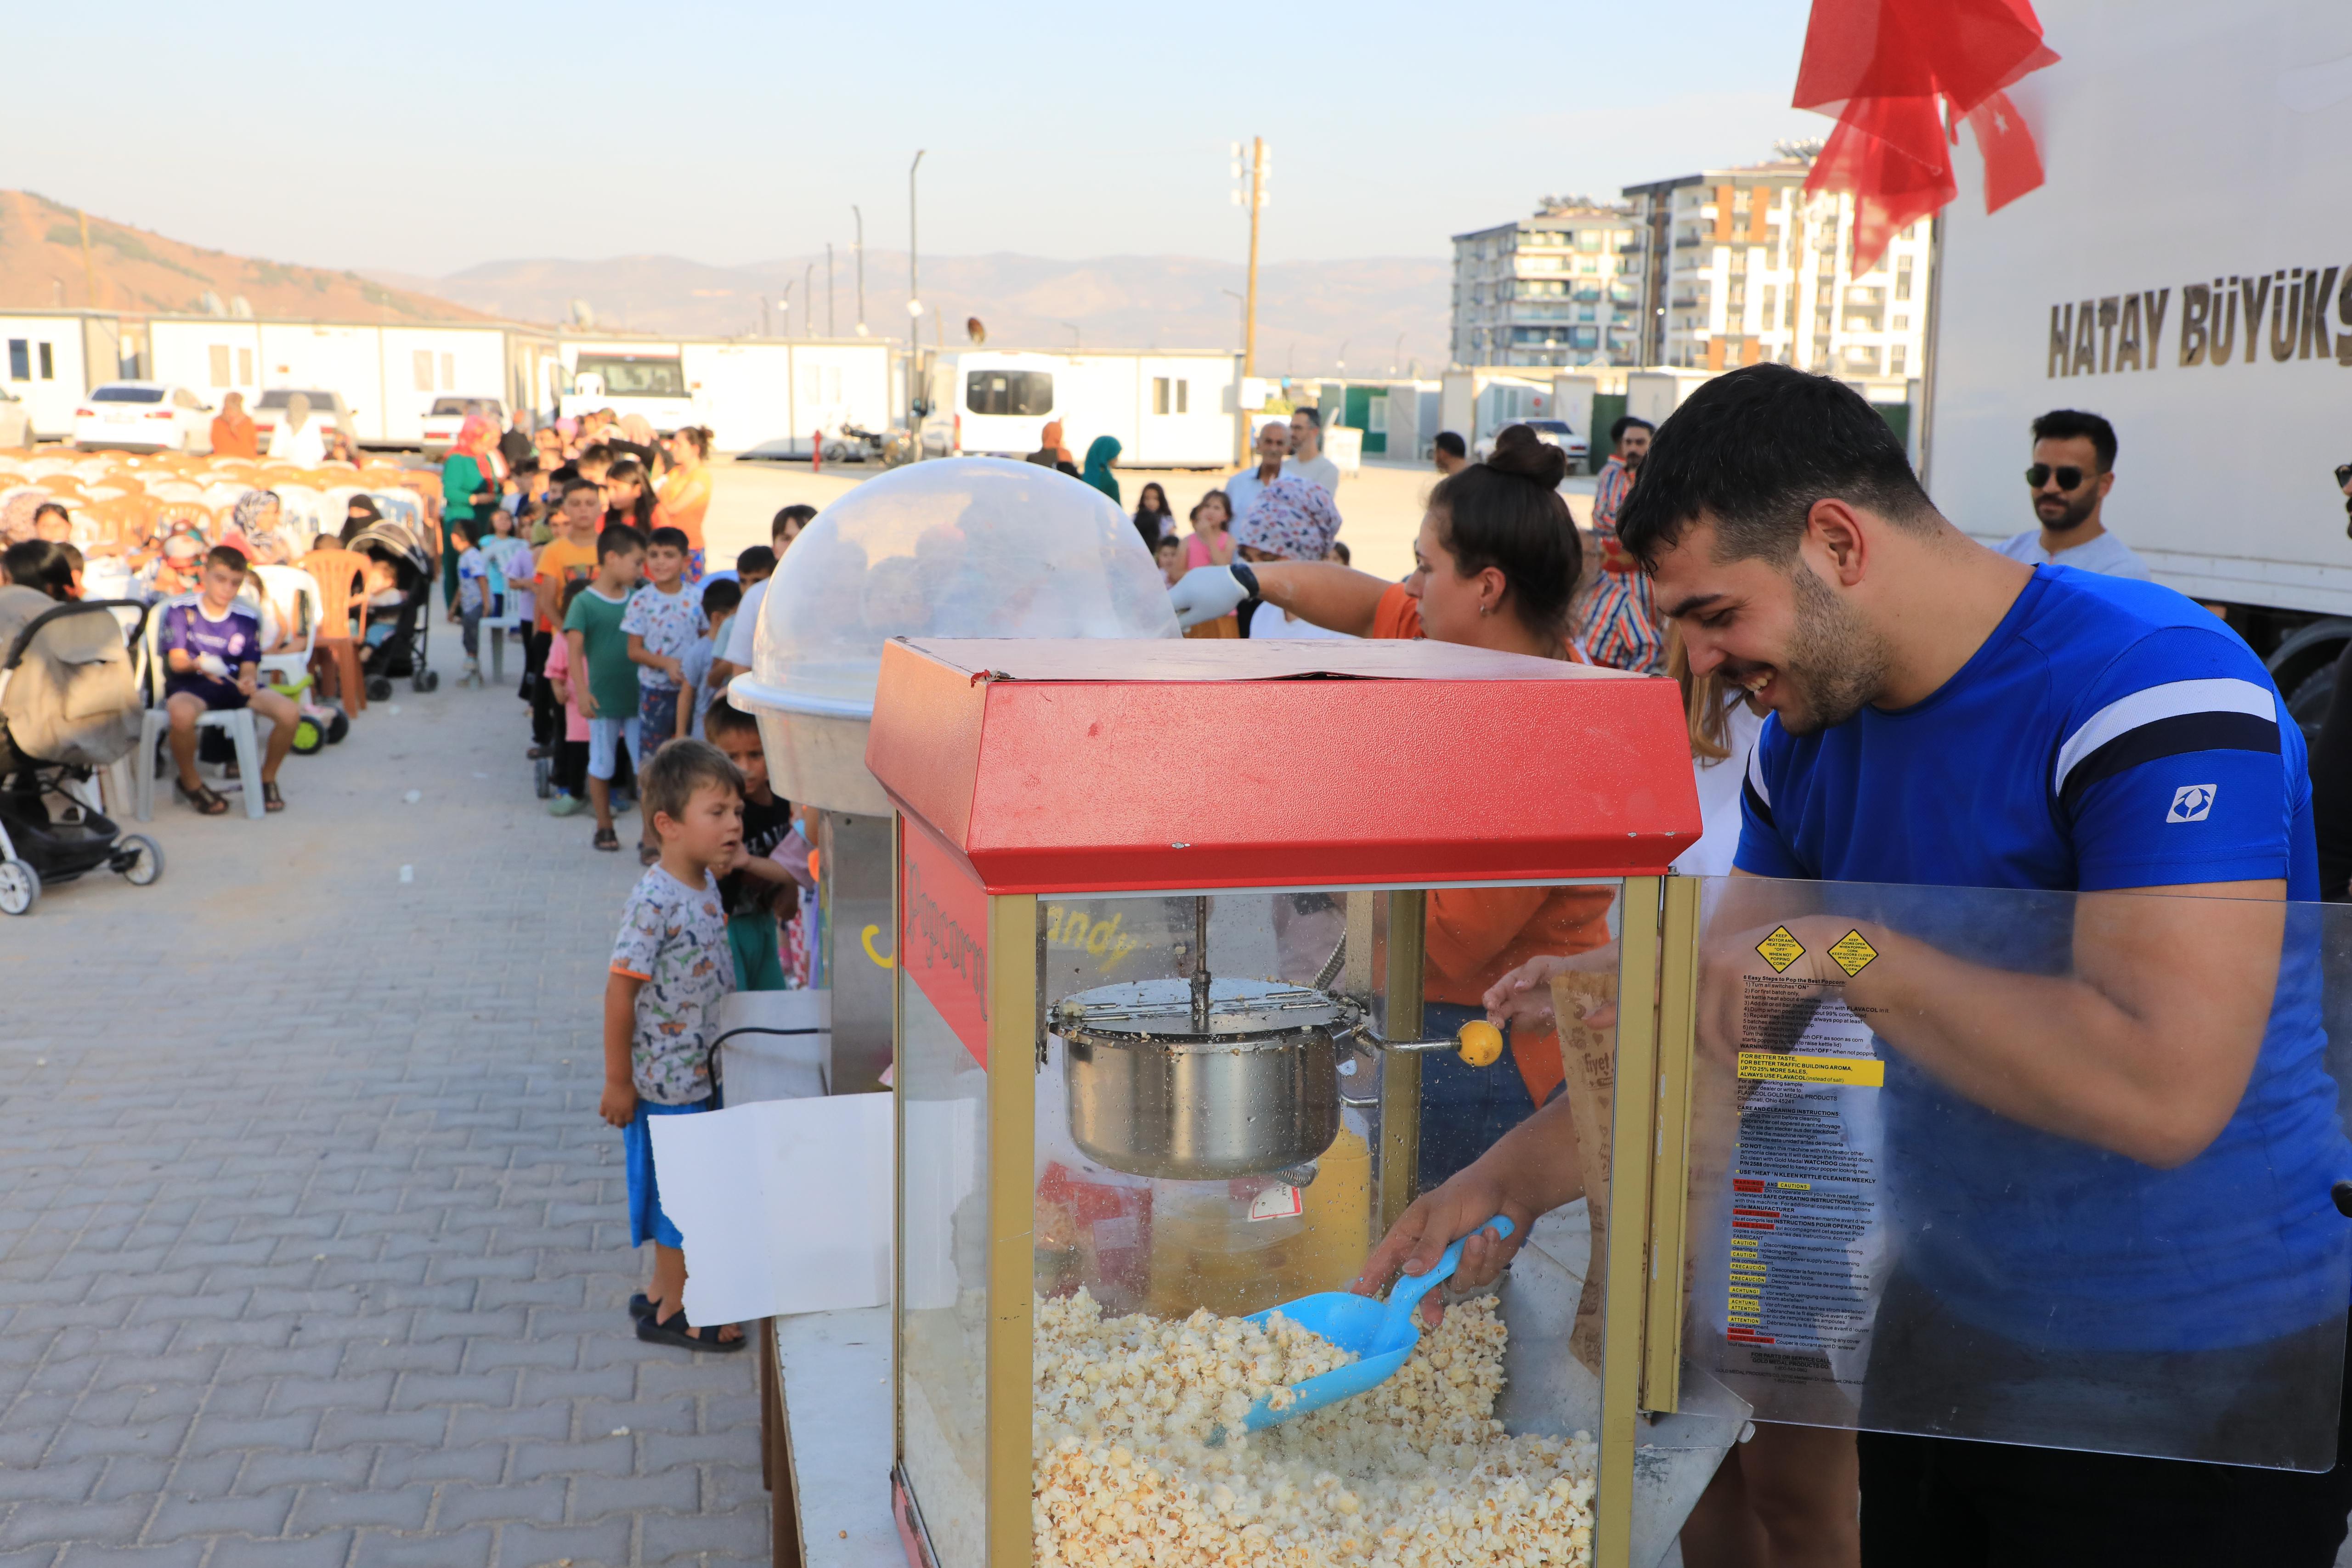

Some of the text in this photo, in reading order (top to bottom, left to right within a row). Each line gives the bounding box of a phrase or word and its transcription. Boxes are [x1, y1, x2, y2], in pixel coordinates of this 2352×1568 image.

[2047, 288, 2171, 378] HATAY
[905, 854, 988, 1021] Popcorn
[1047, 906, 1137, 973] andy
